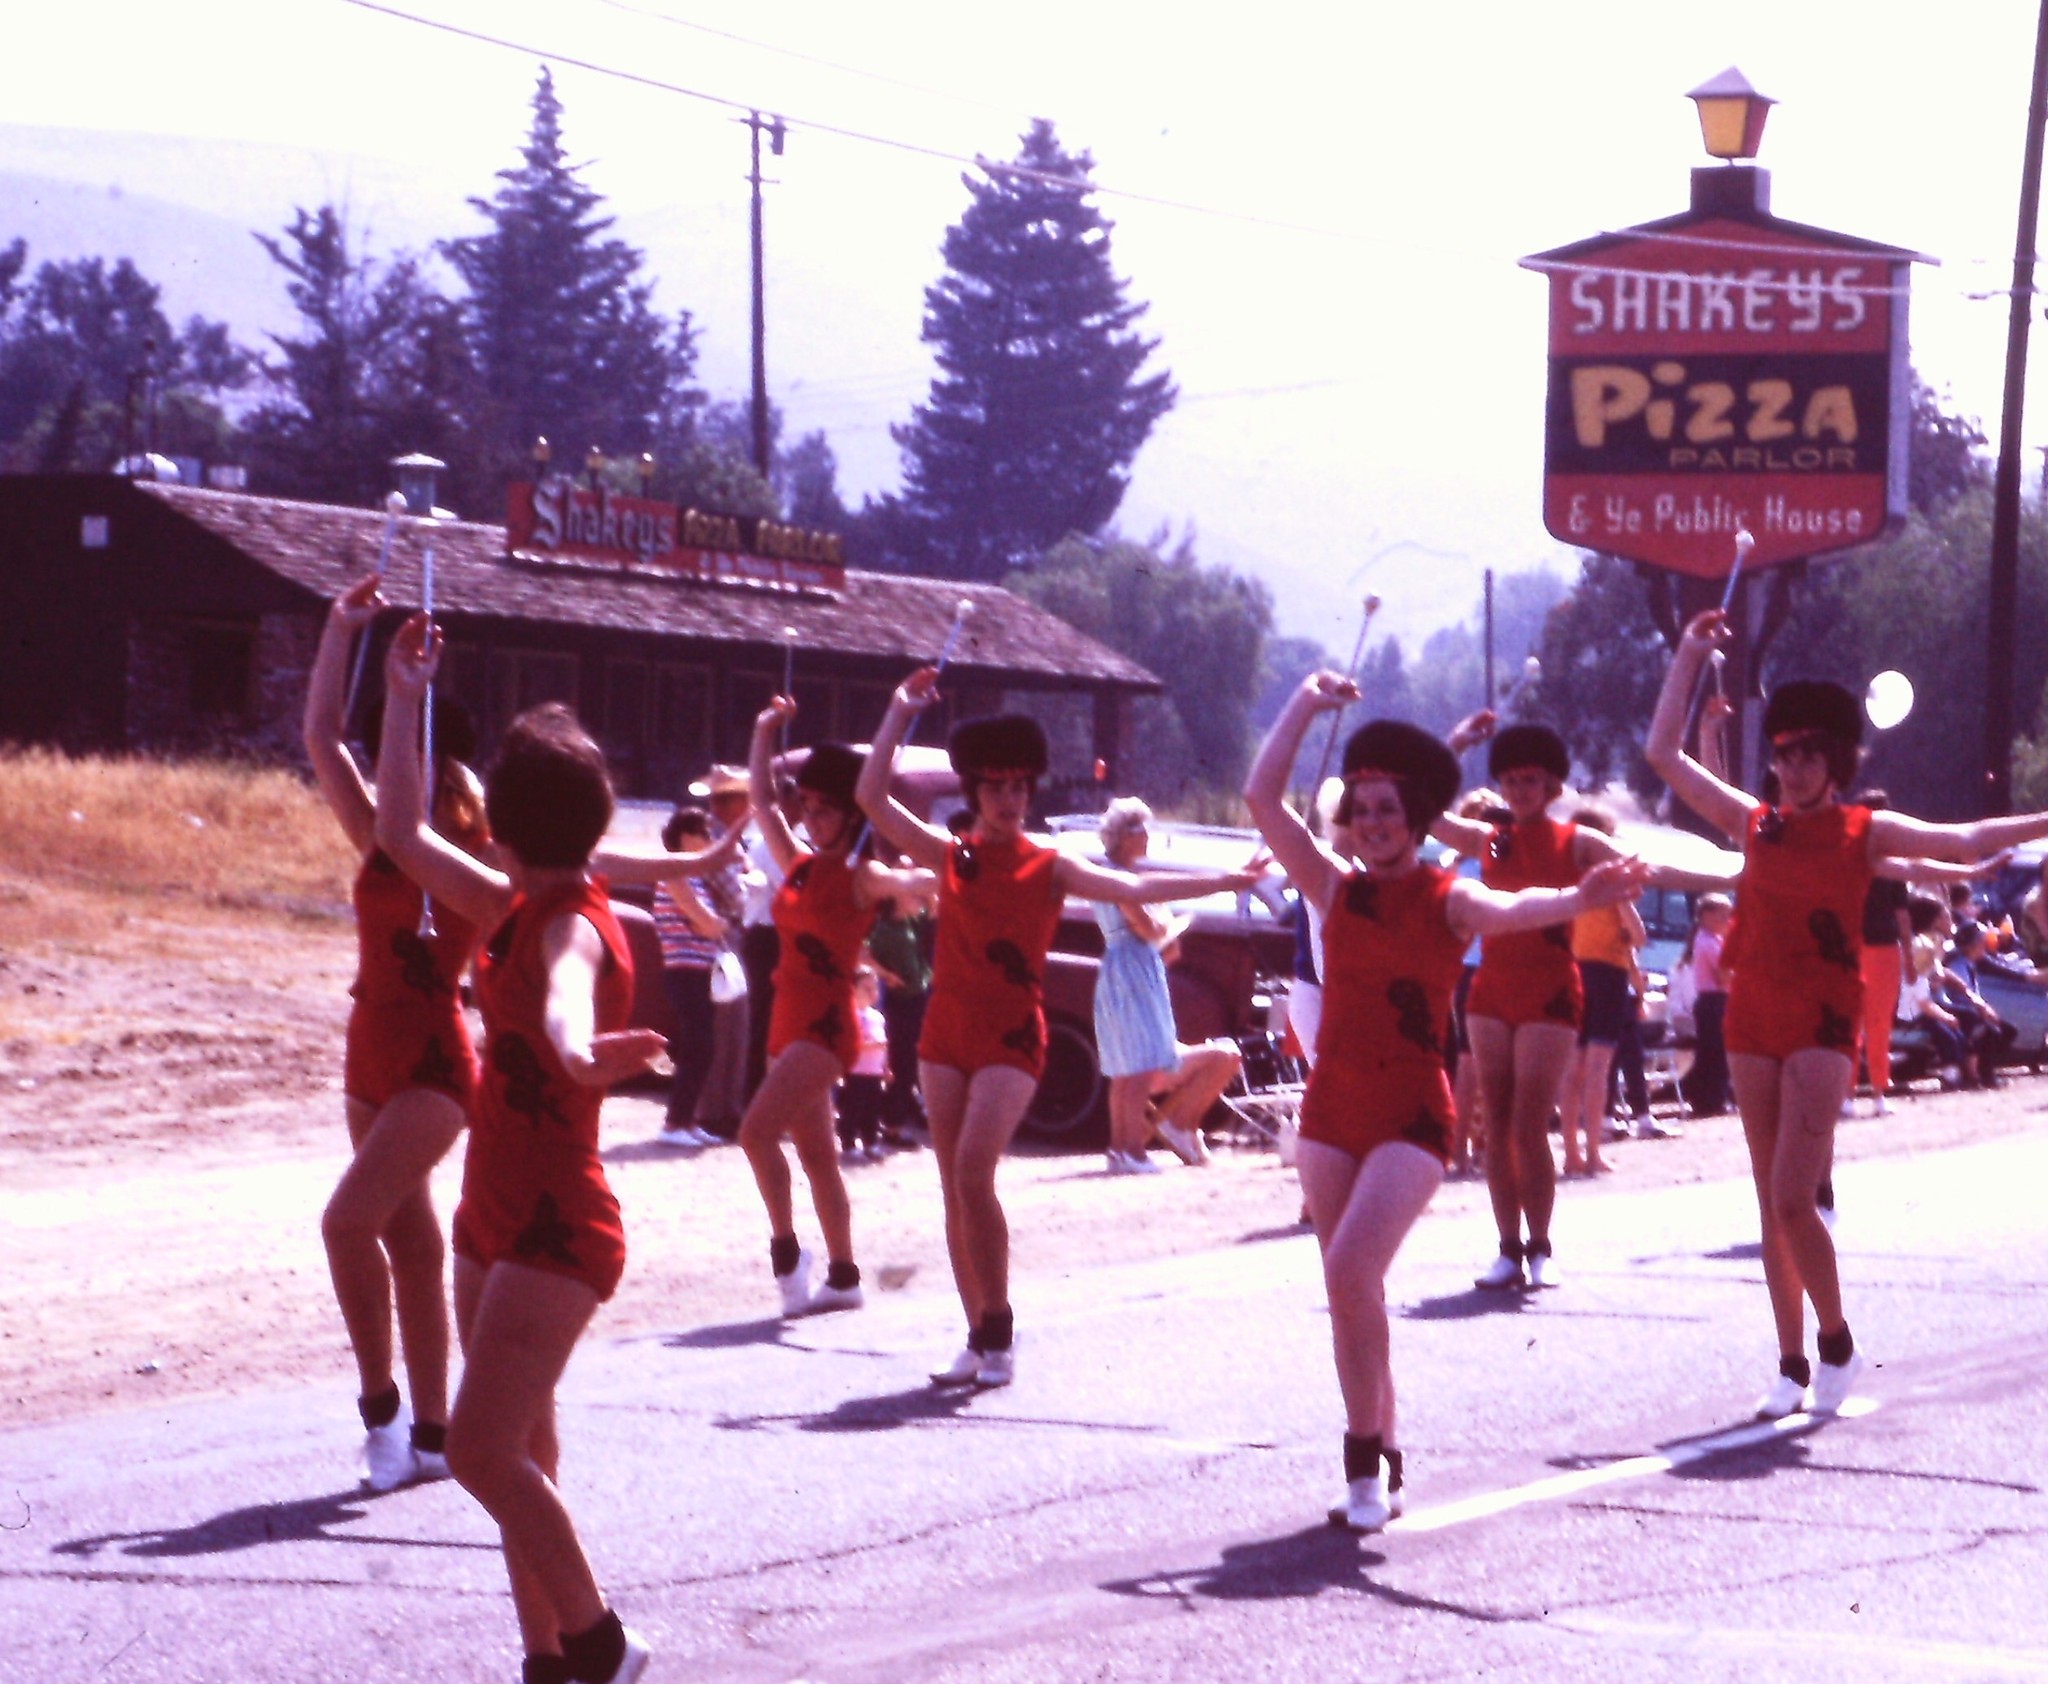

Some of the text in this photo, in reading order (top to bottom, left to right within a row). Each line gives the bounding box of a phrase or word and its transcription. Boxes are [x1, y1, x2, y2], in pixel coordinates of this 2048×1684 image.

[1570, 267, 1866, 332] SHAKEYS
[1669, 449, 1857, 469] PARLOR
[1568, 494, 1862, 534] & Ye Public House
